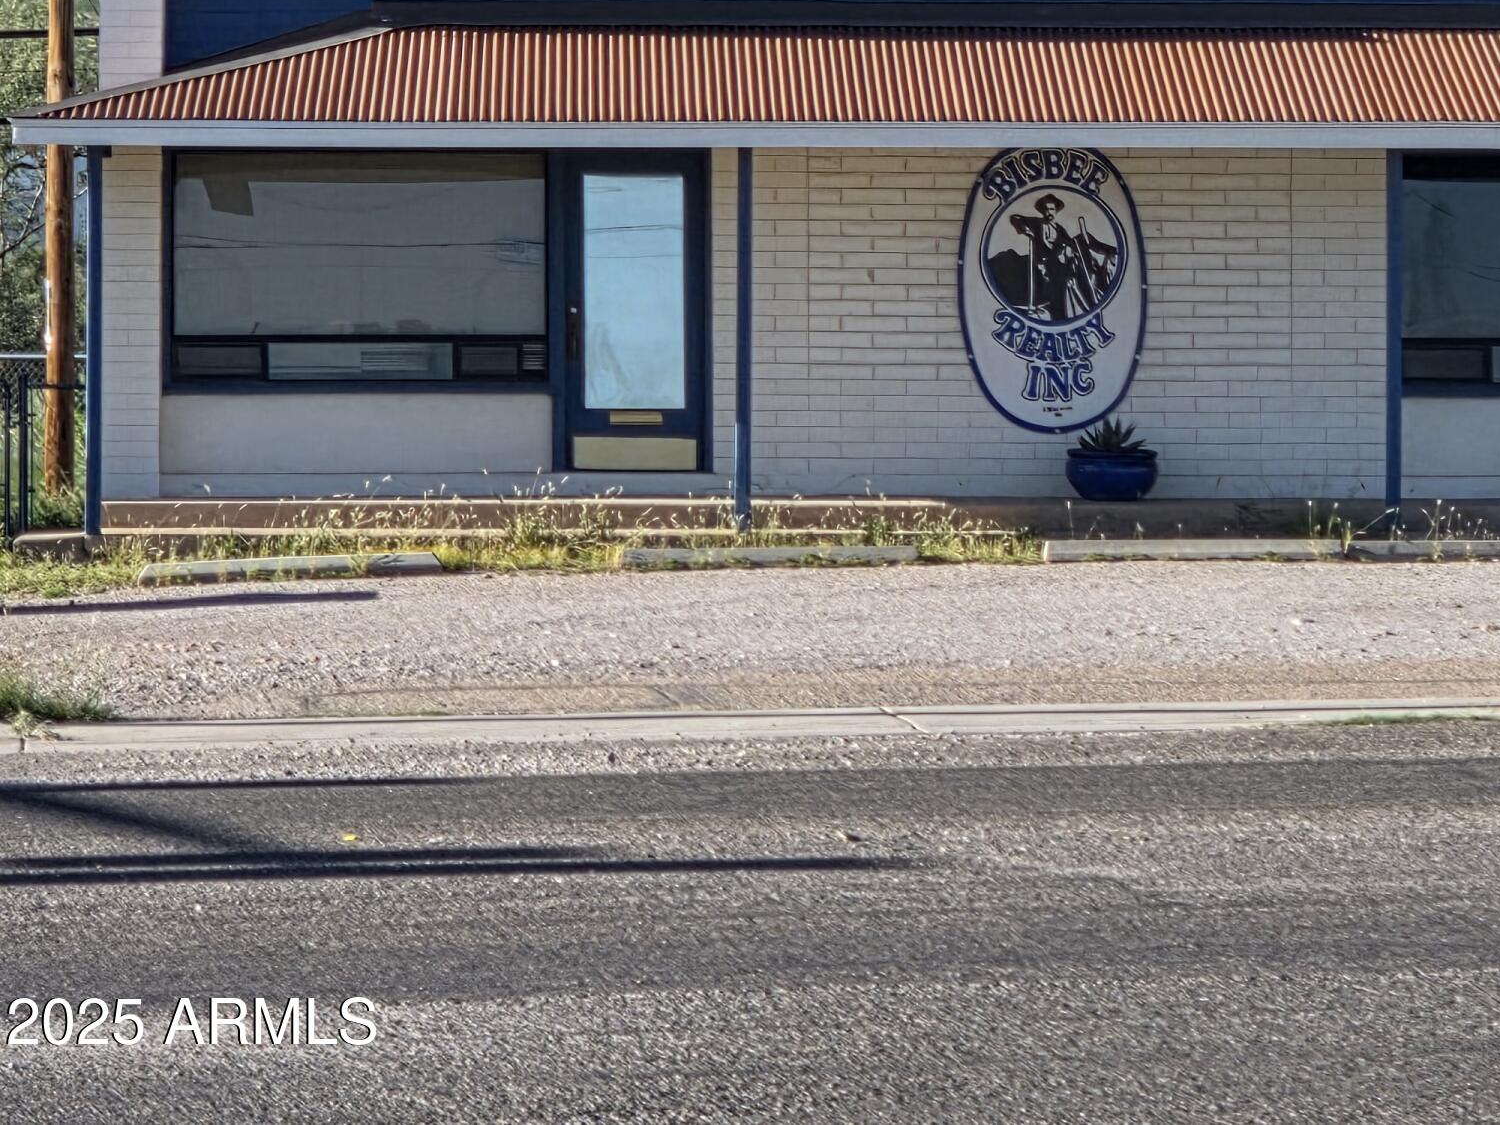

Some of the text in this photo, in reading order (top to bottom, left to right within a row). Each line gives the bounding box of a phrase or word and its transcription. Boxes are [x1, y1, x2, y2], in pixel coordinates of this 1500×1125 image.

[983, 148, 1110, 203] BISBEE
[992, 308, 1115, 363] REALTY
[1022, 358, 1095, 401] INC
